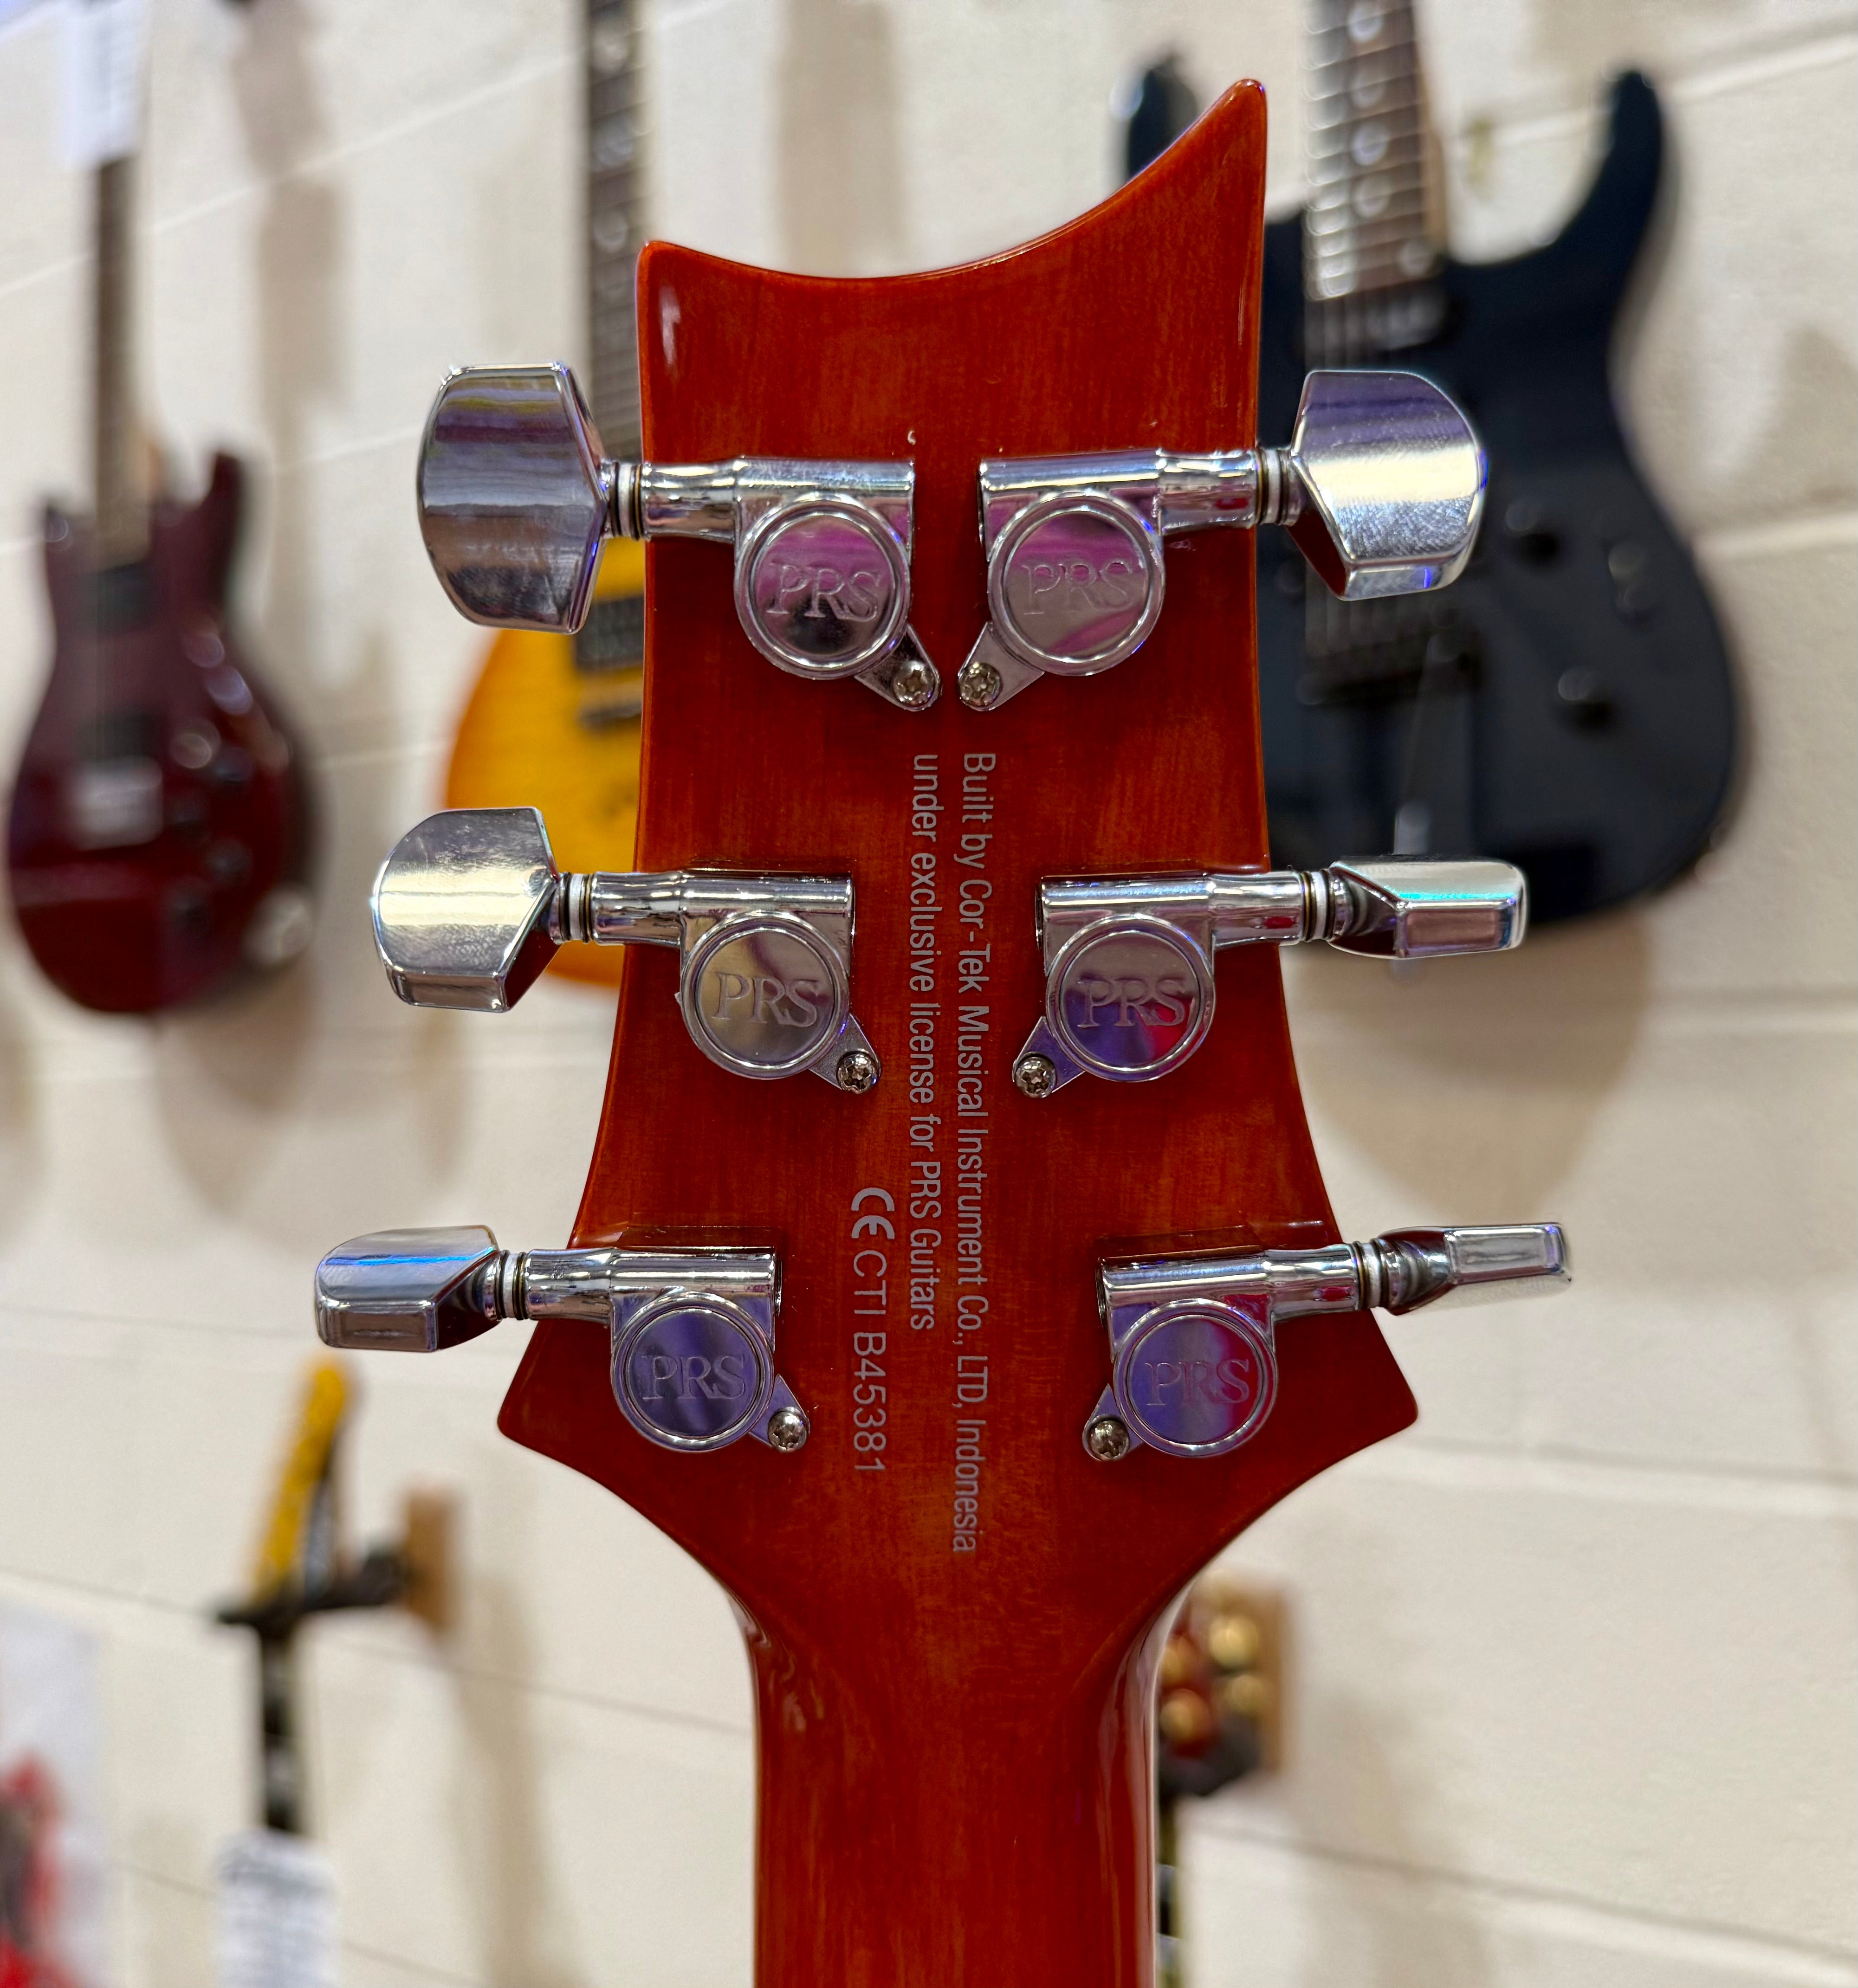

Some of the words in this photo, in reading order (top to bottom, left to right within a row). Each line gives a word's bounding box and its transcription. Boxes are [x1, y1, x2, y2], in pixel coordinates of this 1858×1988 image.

[766, 561, 881, 622] PRS
[1022, 561, 1134, 615] PRS
[912, 755, 944, 842] under
[962, 754, 996, 823] Built
[953, 834, 992, 869] by
[909, 853, 943, 992] exclusive
[958, 879, 992, 993] Cor-Tek
[712, 972, 821, 1027] PRS
[1075, 978, 1188, 1028] PRS
[909, 1003, 941, 1103] license
[958, 1006, 989, 1116] Musical
[909, 1113, 941, 1152] for
[910, 1161, 941, 1219] PRS
[958, 1129, 989, 1285] Instrument
[854, 1250, 887, 1315] CTI
[910, 1228, 942, 1330] Guitars
[952, 1295, 989, 1344] Co.,
[641, 1355, 745, 1400] PRS
[853, 1332, 886, 1470] B45381
[952, 1356, 988, 1408] LTD,
[1145, 1360, 1250, 1406] PRS
[953, 1420, 986, 1552] Indonesia
